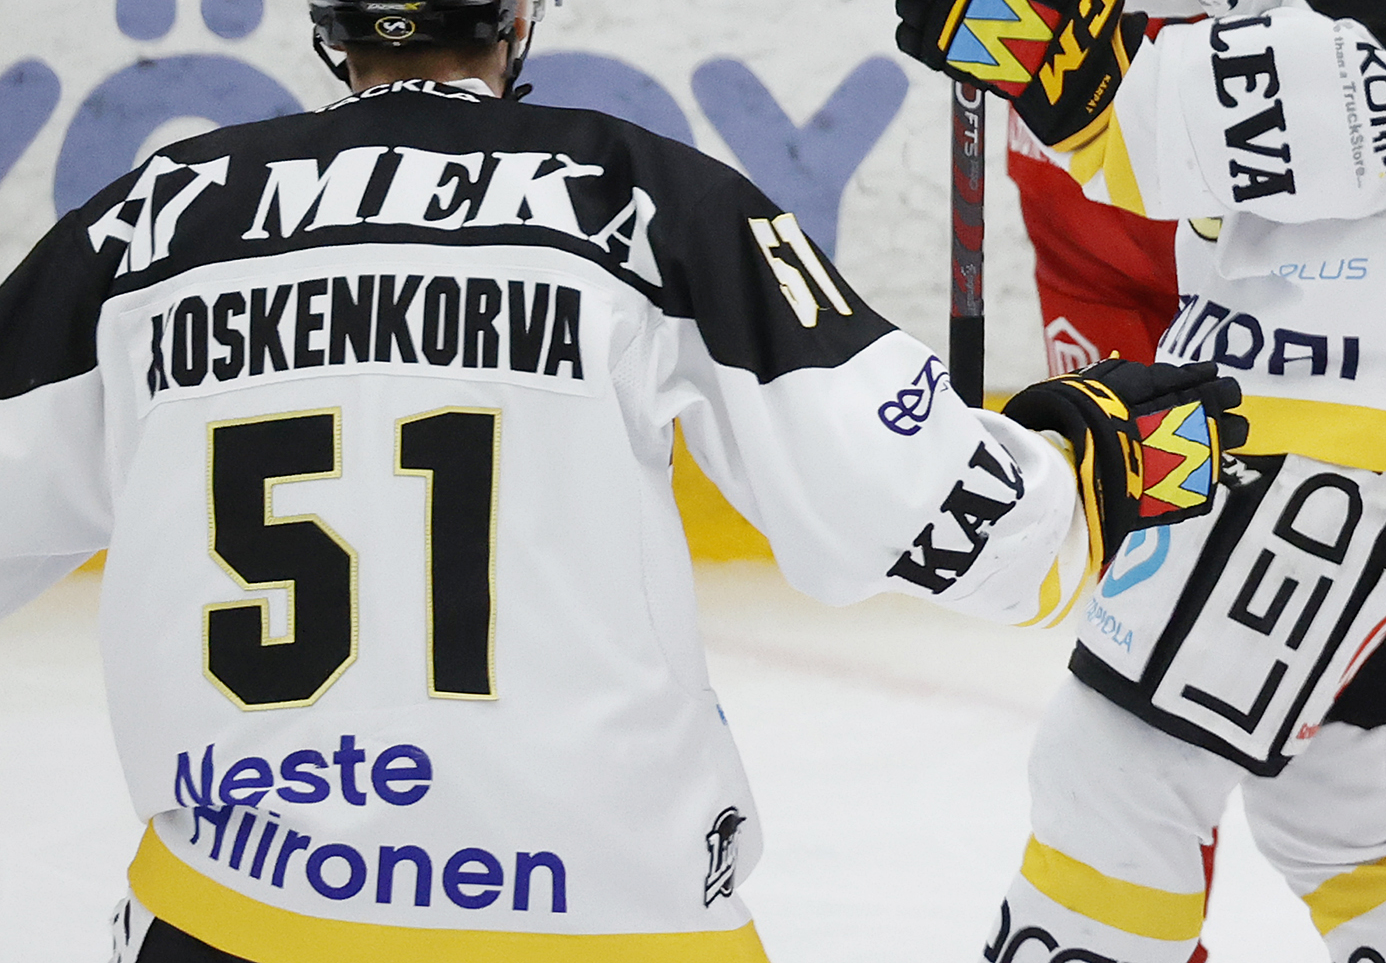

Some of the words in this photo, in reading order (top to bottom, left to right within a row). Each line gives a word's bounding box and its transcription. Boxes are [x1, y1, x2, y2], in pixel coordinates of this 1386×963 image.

[241, 146, 662, 287] MEKA
[747, 211, 853, 329] 51
[202, 405, 503, 713] 51
[173, 734, 433, 810] Neste
